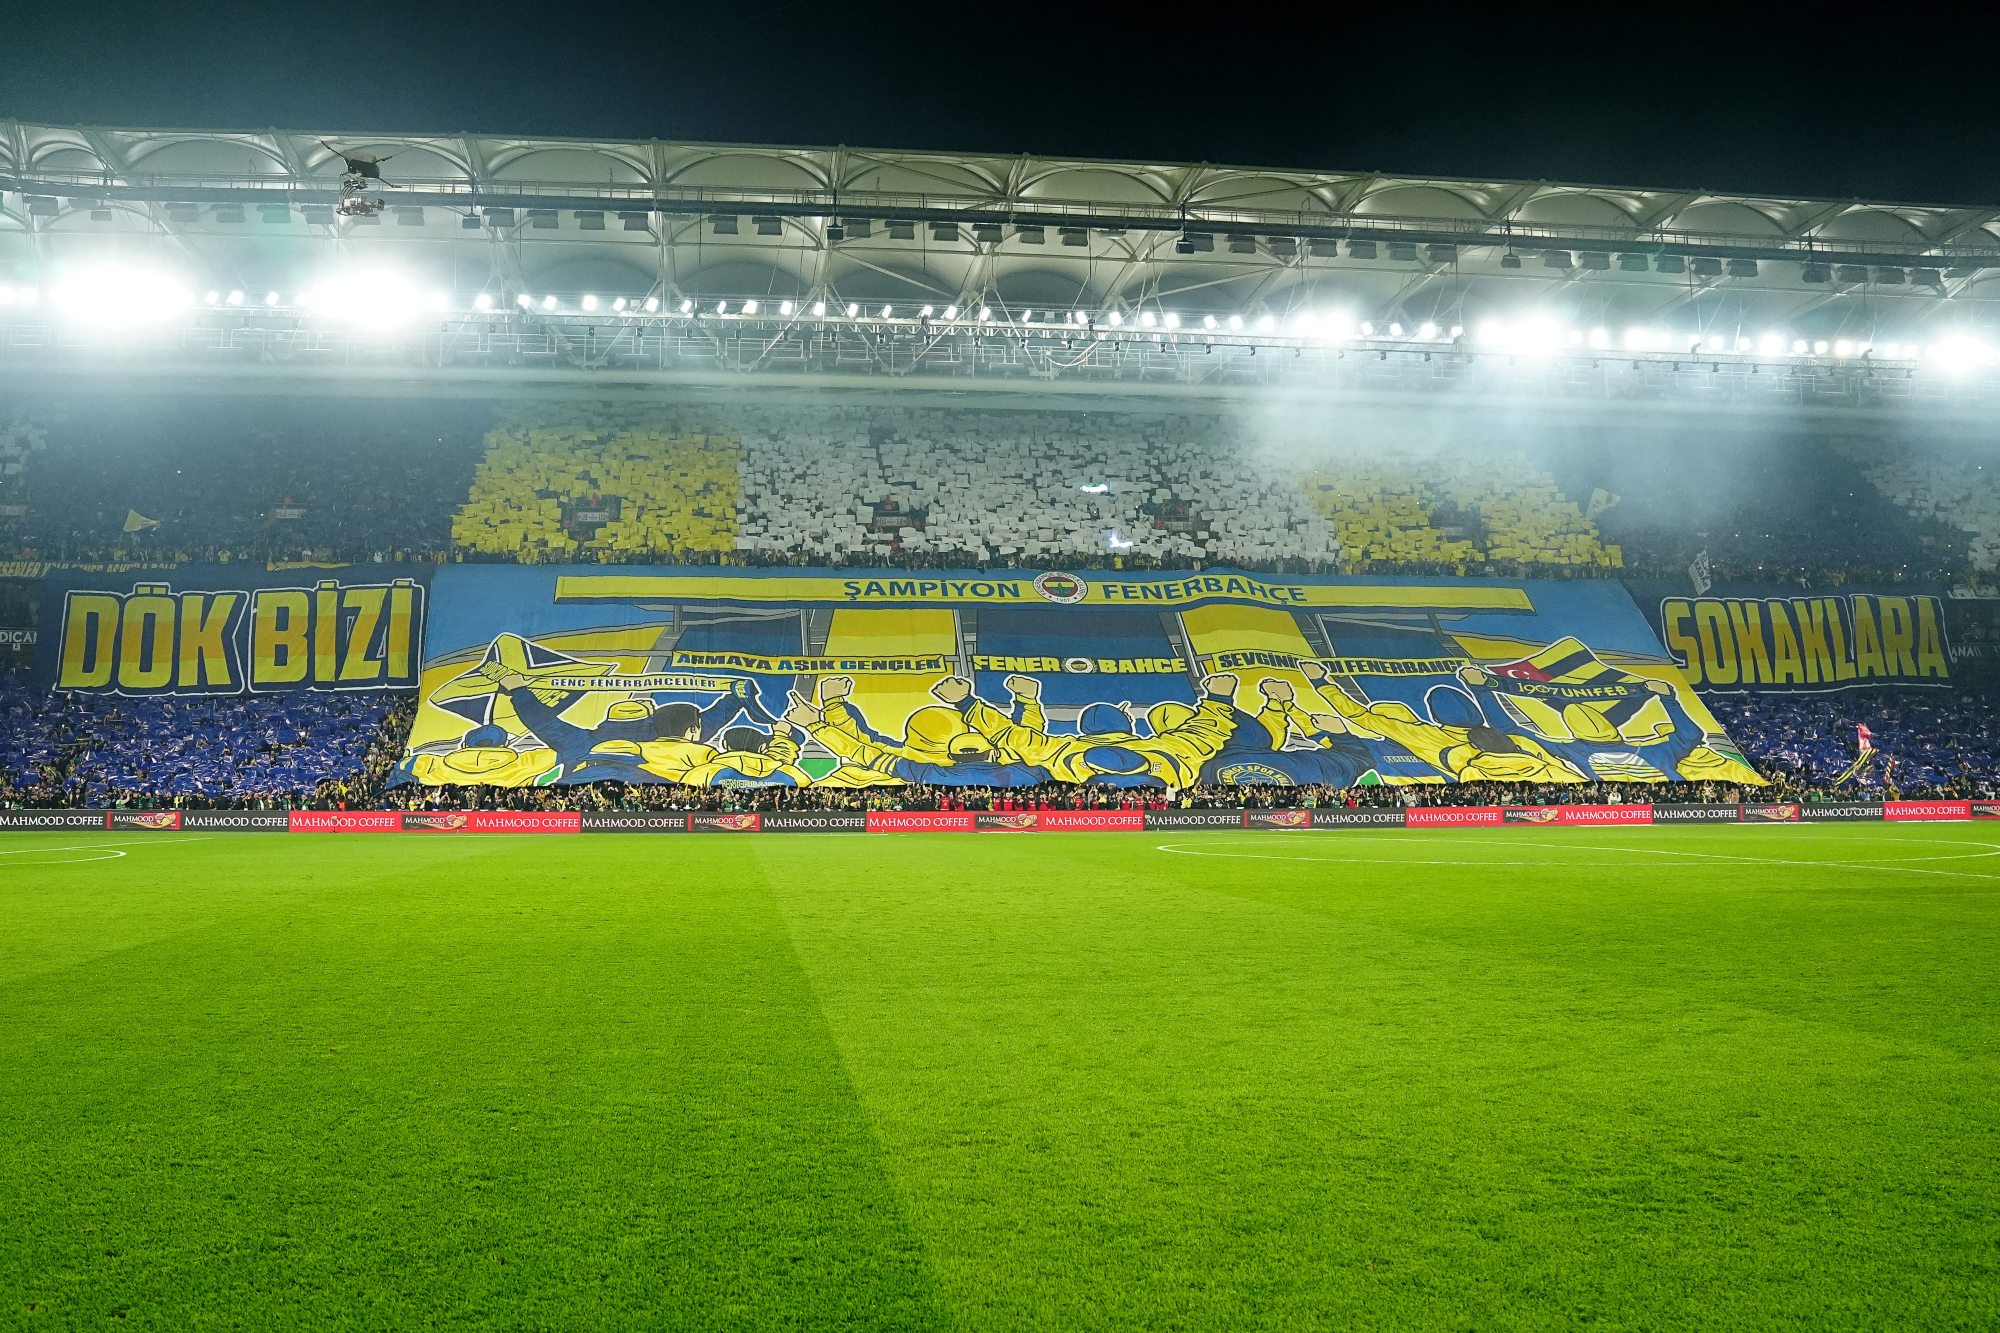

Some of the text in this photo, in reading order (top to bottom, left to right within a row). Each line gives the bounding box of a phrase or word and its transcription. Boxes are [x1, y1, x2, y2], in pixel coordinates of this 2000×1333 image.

[843, 579, 1021, 601] ŞAMPİYON
[1101, 577, 1308, 606] FENERBAHÇE
[58, 579, 413, 689] DÖK BİZİ
[1663, 595, 1949, 685] SOKAKLARA
[676, 653, 772, 671] ARMAYA
[972, 655, 1062, 673] FENER
[1517, 682, 1558, 695] 1907
[1566, 810, 1650, 820] MAHMOOD COFFEE
[1654, 809, 1737, 818] MAHMOOD COFFEE
[1802, 806, 1883, 816] MAHMOOD COFFEE
[1886, 806, 1965, 816] MAHMOOD COFFEE
[0, 816, 103, 826] MAHMOOD COFFEE
[185, 816, 288, 826] MAHMOOD COFFEE
[292, 816, 395, 826] MAHMOOD COFFEE
[869, 817, 968, 826] MAHMOOD COFFEE
[1046, 816, 1142, 826] MAHMOOD COFFEE
[1148, 815, 1241, 824] MAHMOOD COFFEE
[1314, 814, 1405, 824] MAHMOOD COFFEE
[1408, 812, 1497, 822] MAHMOOD COFFEE
[476, 818, 579, 828] MAHMOOD COFFEE
[582, 818, 684, 828] MAHMOOD COFFEE
[765, 818, 865, 828] MAHMOOD COFFEE
